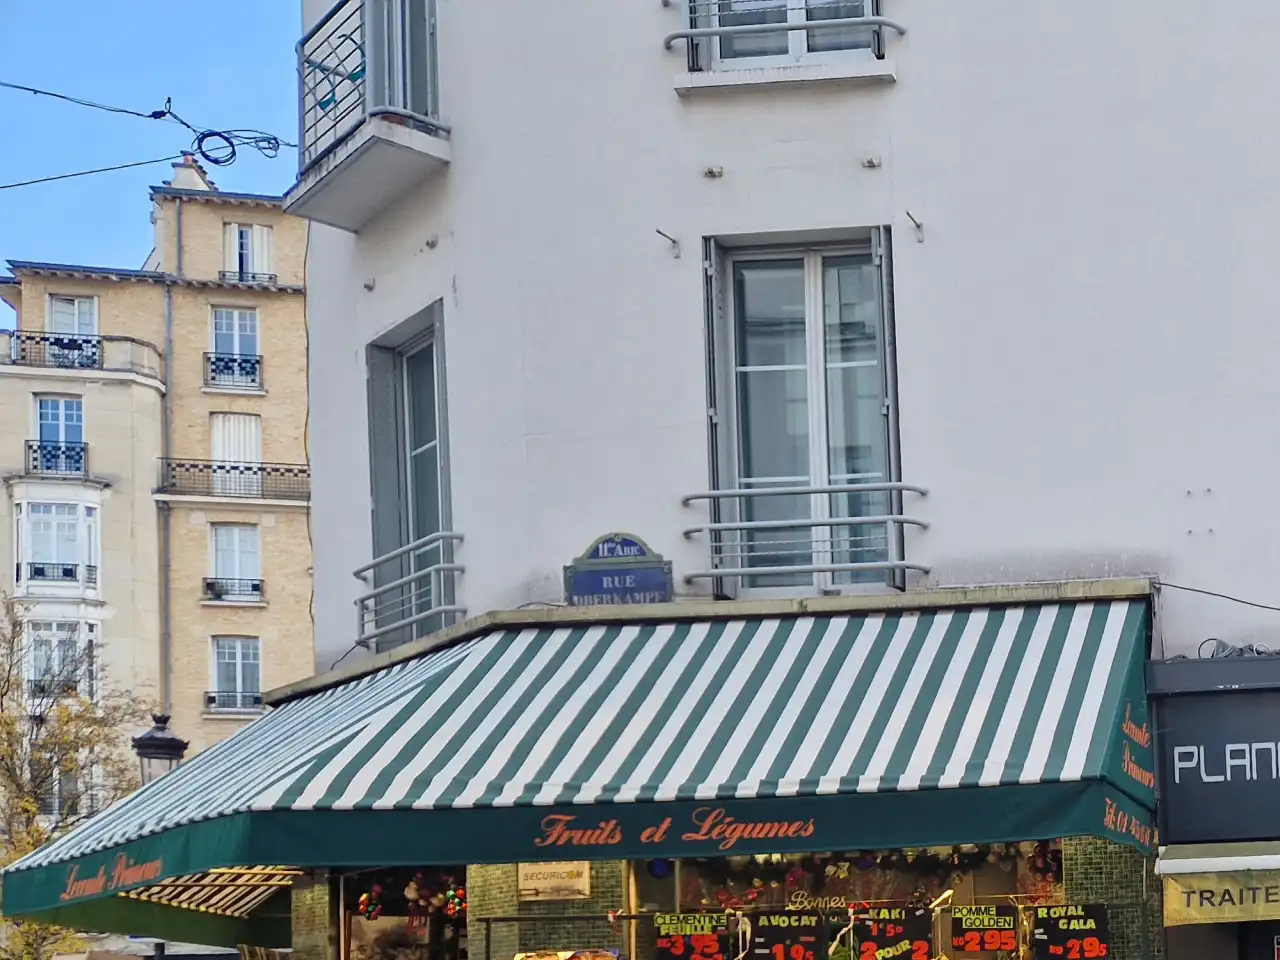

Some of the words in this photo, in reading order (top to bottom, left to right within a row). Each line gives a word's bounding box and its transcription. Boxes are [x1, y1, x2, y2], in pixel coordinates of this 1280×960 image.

[602, 575, 636, 589] RUE
[534, 814, 622, 847] Fruits
[640, 816, 673, 843] et
[682, 806, 815, 850] Légumes
[524, 869, 583, 881] SECURICOM
[868, 908, 906, 920] KAKI
[953, 907, 995, 917] POMME
[1037, 905, 1085, 919] ROYAL
[655, 915, 727, 926] CLEMENTINE
[759, 915, 818, 928] AVOCAT
[964, 917, 1013, 928] GOLDEN
[1058, 918, 1097, 930] GALA
[660, 925, 713, 936] FEUILLE
[875, 939, 913, 960] POUR
[911, 940, 929, 960] 2
